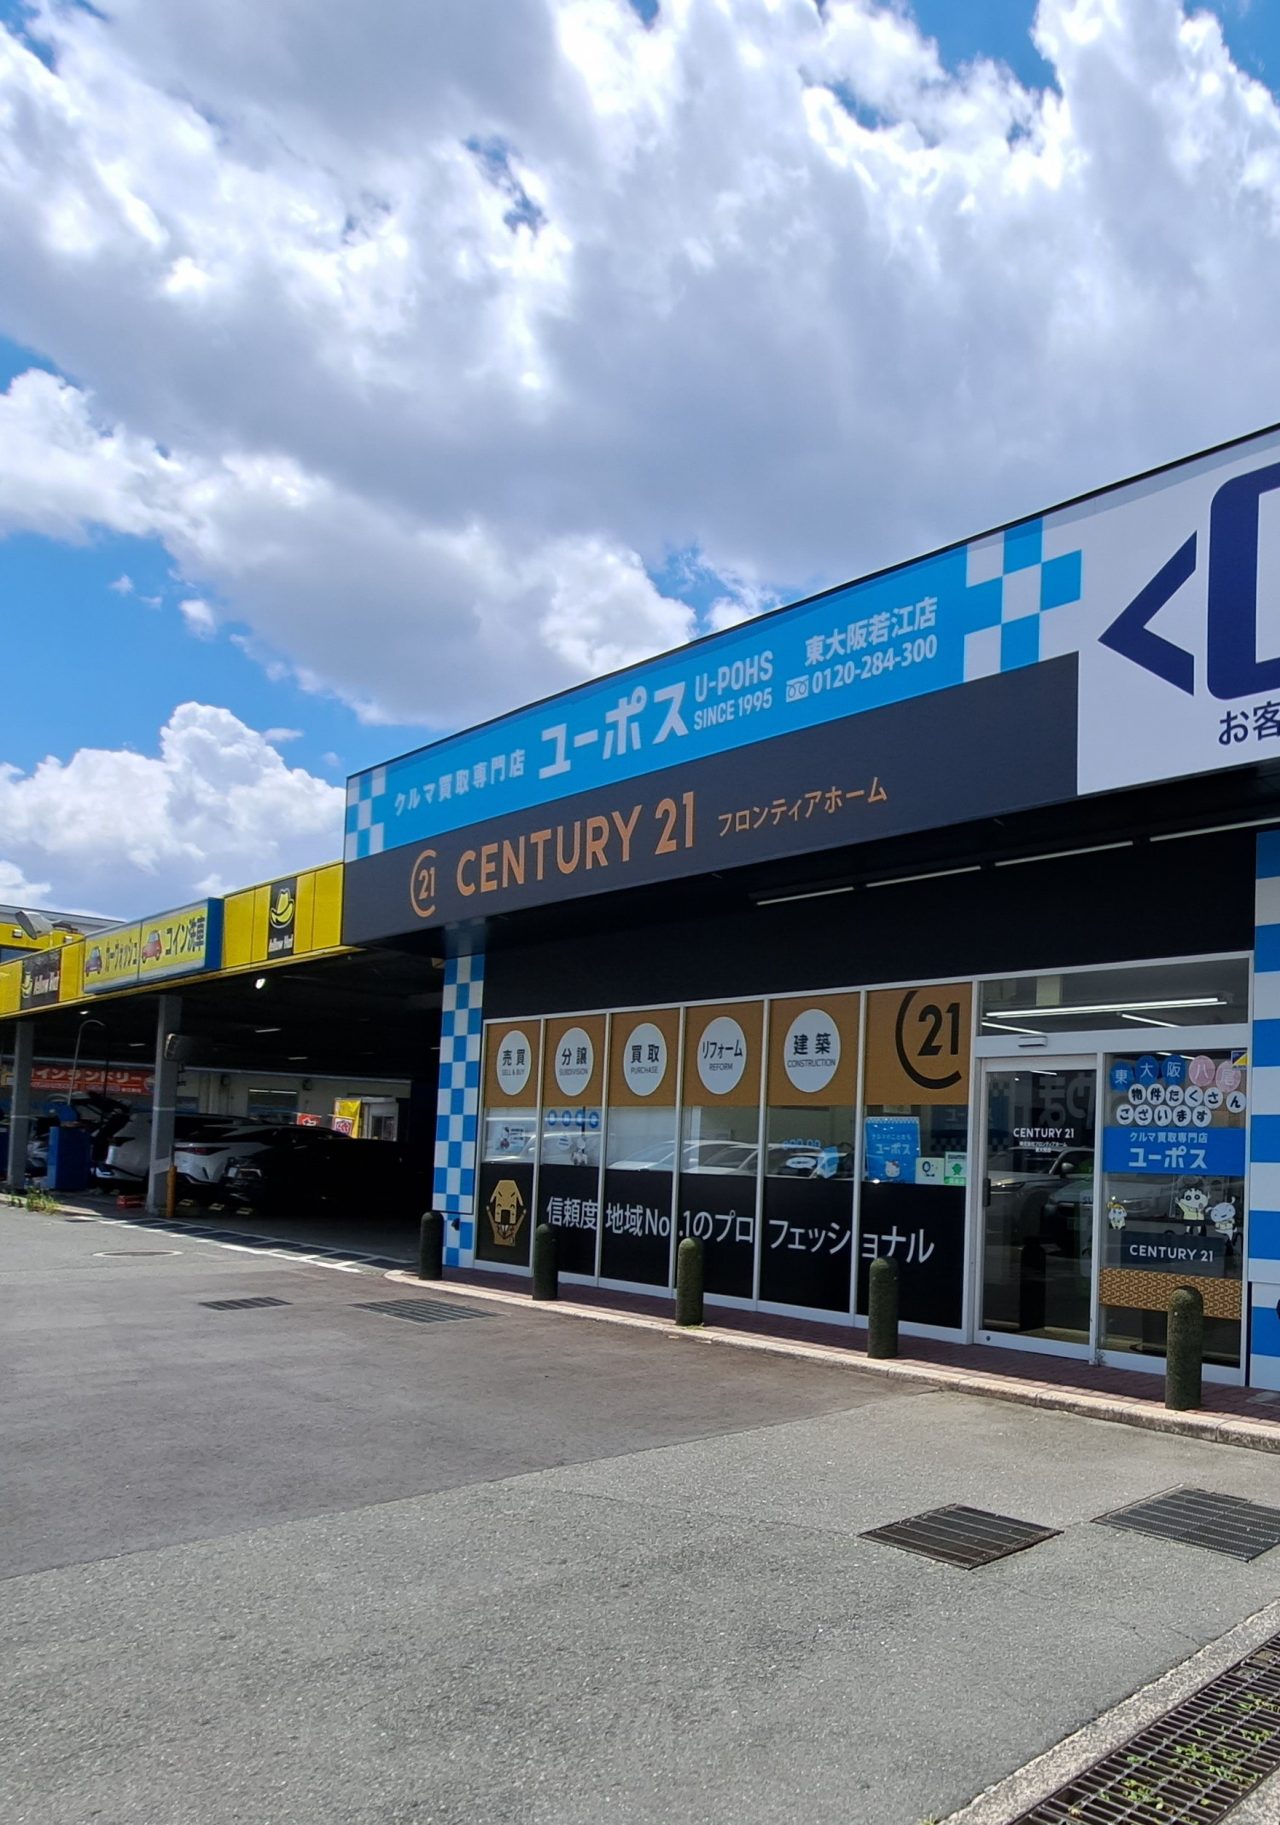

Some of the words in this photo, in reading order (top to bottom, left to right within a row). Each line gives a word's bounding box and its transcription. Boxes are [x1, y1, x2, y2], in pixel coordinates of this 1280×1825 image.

[805, 597, 938, 666] 東大阪若江店
[811, 634, 938, 694] 0120-284-300
[695, 651, 774, 703] U-POHS
[693, 701, 735, 732] SINCE
[737, 693, 773, 720] 1995
[393, 748, 526, 817] クルマ買取専門店
[538, 680, 689, 780] ユーポス
[718, 776, 888, 838] フロンティアホーム
[456, 804, 643, 898] CENTURY
[654, 791, 696, 855] 21
[165, 917, 206, 956] コイン洗車
[702, 1040, 743, 1059] リフォーム
[793, 1032, 831, 1056] 建築
[502, 1048, 526, 1066] 売買
[561, 1047, 588, 1066] 分譲
[631, 1044, 660, 1064] 買取
[787, 1059, 836, 1068] CONSTRUCTION
[32, 1068, 142, 1083] インランドリー
[631, 1066, 659, 1074] PURCHASE
[709, 1063, 733, 1071] REFORM
[1131, 1087, 1241, 1108] 物件たくさん
[1119, 1110, 1208, 1123] ございます
[1013, 1128, 1062, 1138] CENTURY
[1065, 1128, 1075, 1138] 21
[1129, 1132, 1209, 1144] クルマ買取専門店
[875, 1143, 911, 1155] ユーポス
[1128, 1146, 1208, 1170] ユーポス
[1129, 1244, 1197, 1260] CENTURY
[1200, 1249, 1214, 1262] 21
